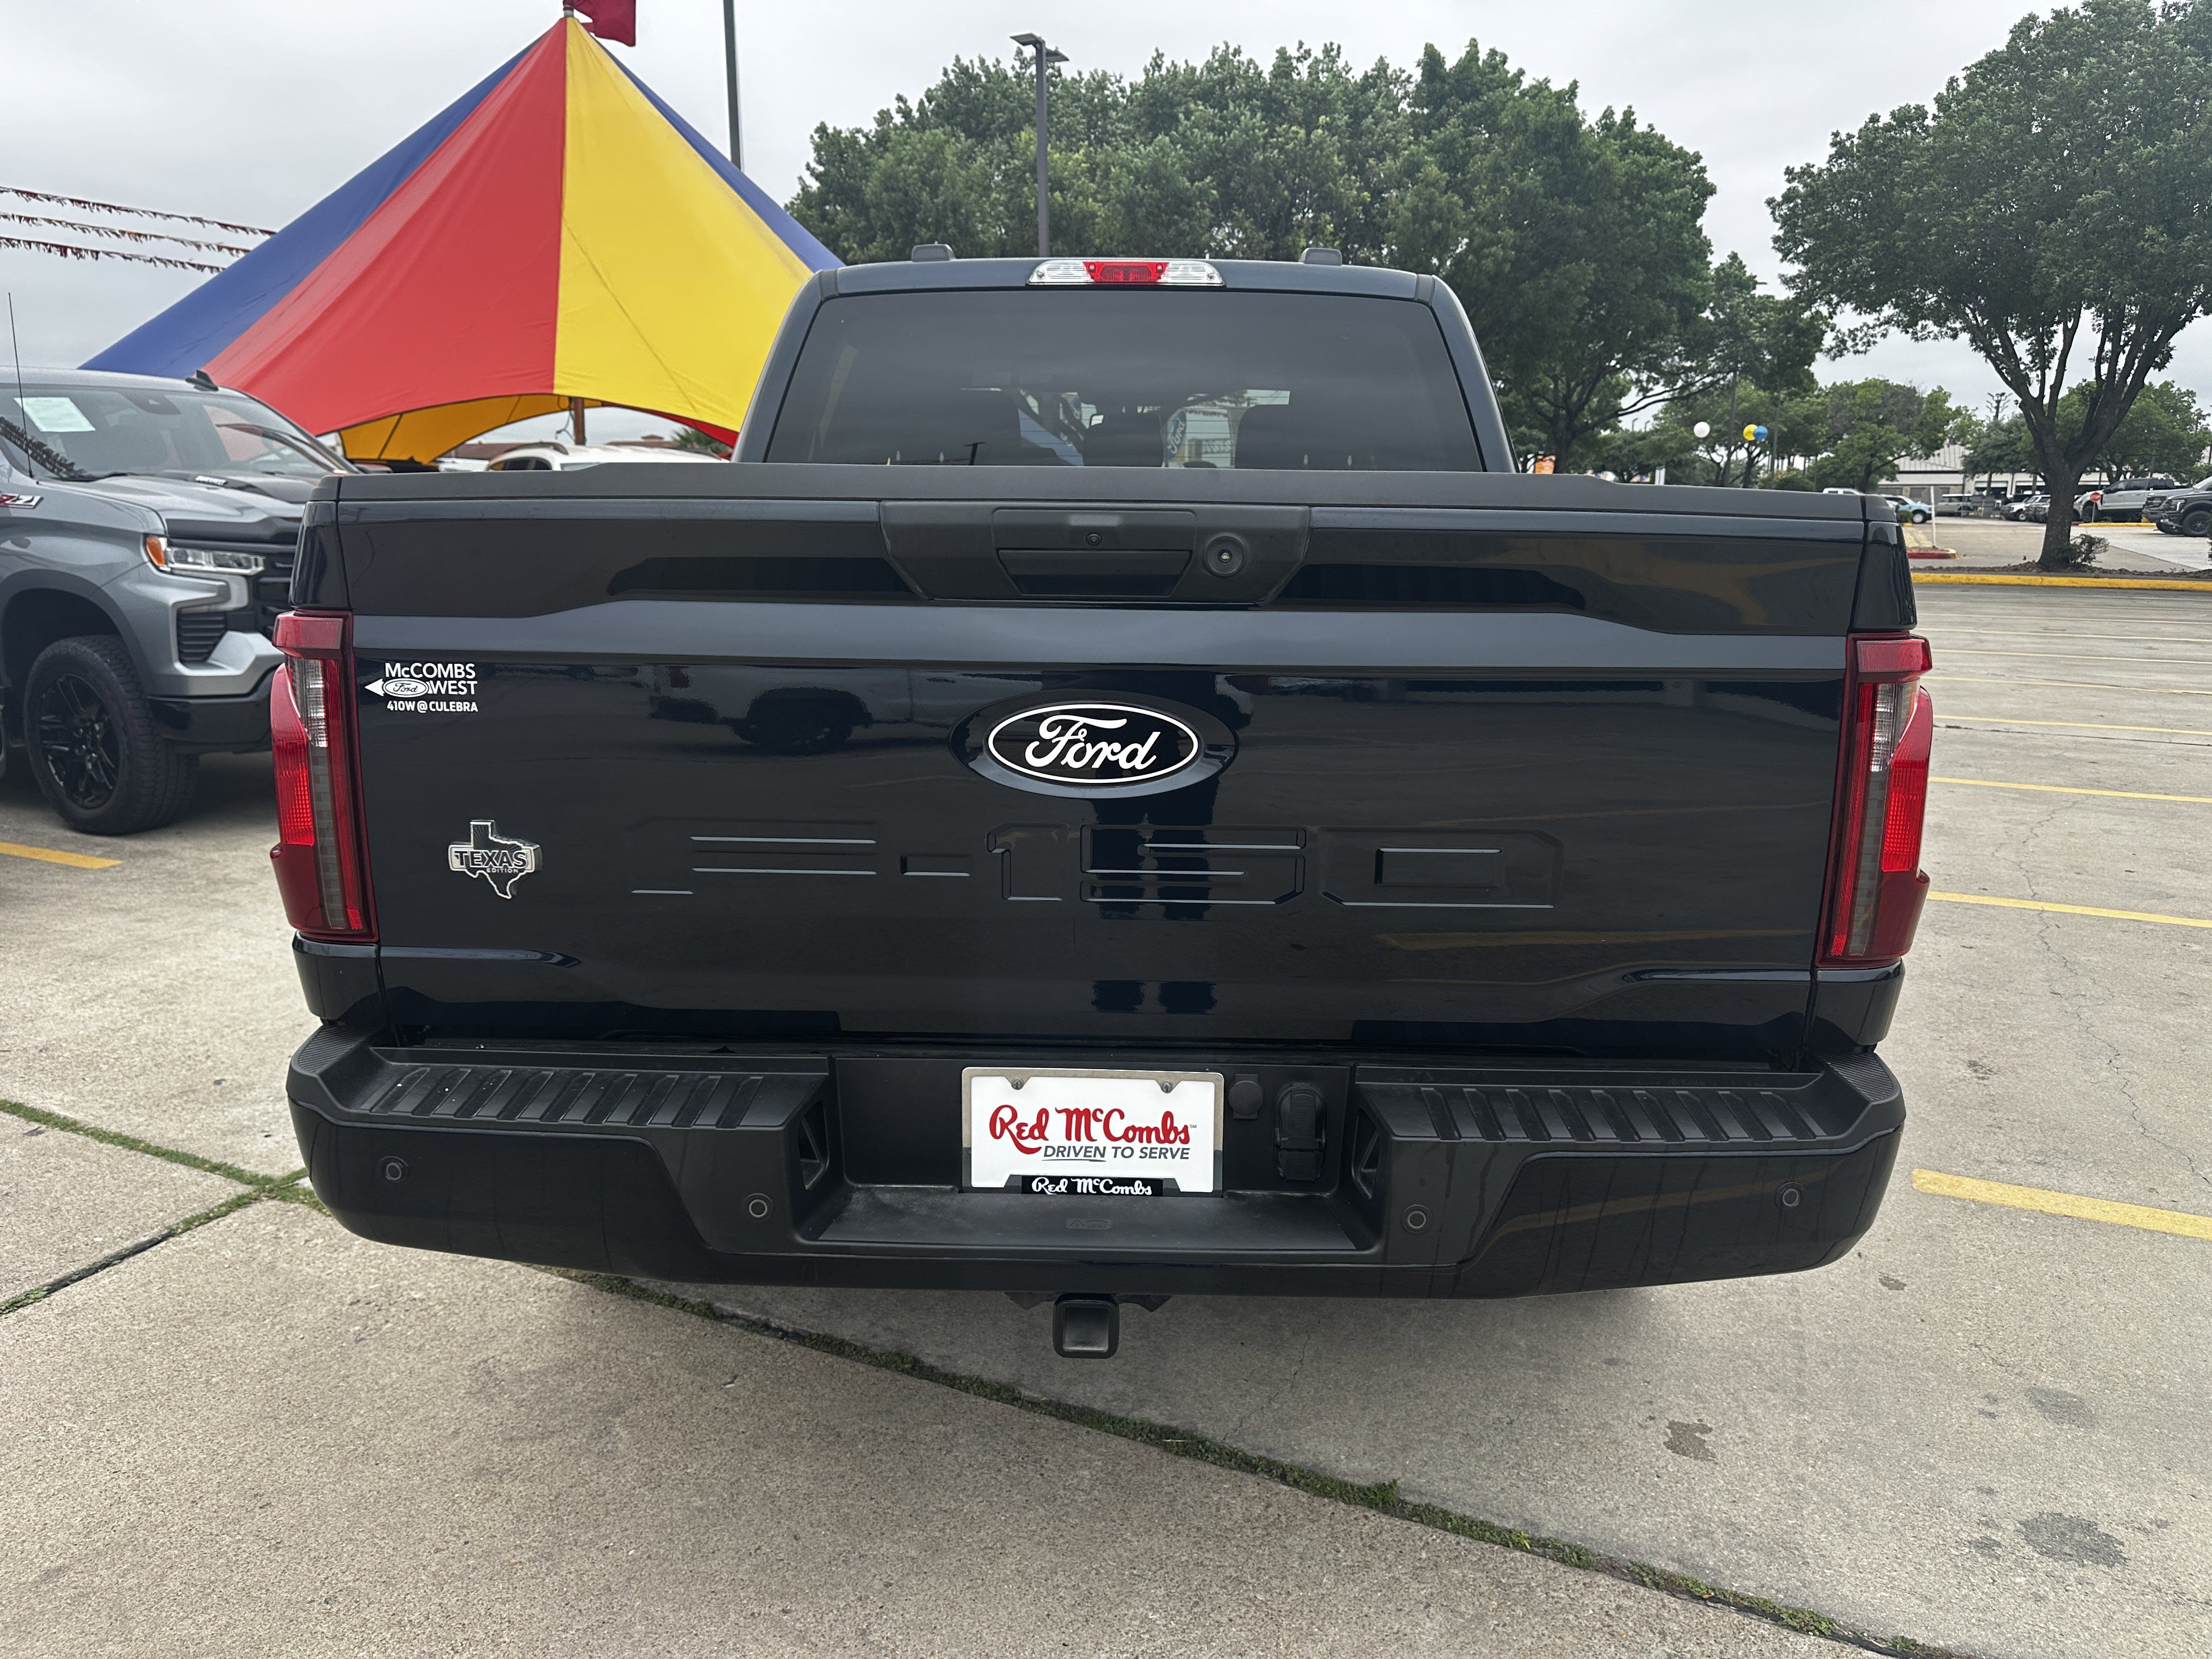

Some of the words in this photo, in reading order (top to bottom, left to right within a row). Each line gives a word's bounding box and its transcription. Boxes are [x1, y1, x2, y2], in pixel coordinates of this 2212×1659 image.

[385, 662, 476, 679] McCOMBS
[393, 682, 418, 692] Ford
[427, 680, 478, 695] WEST
[1025, 714, 1161, 770] Ford
[454, 850, 528, 868] TEXAS
[628, 816, 1565, 911] F-150
[989, 1104, 1049, 1155] Red
[1055, 1107, 1190, 1144] McCombs
[1043, 1145, 1107, 1159] DRIVEN
[1111, 1146, 1133, 1159] TO
[1138, 1147, 1190, 1160] SERVE
[1031, 1177, 1068, 1195] Red
[1070, 1178, 1152, 1195] McCombs
